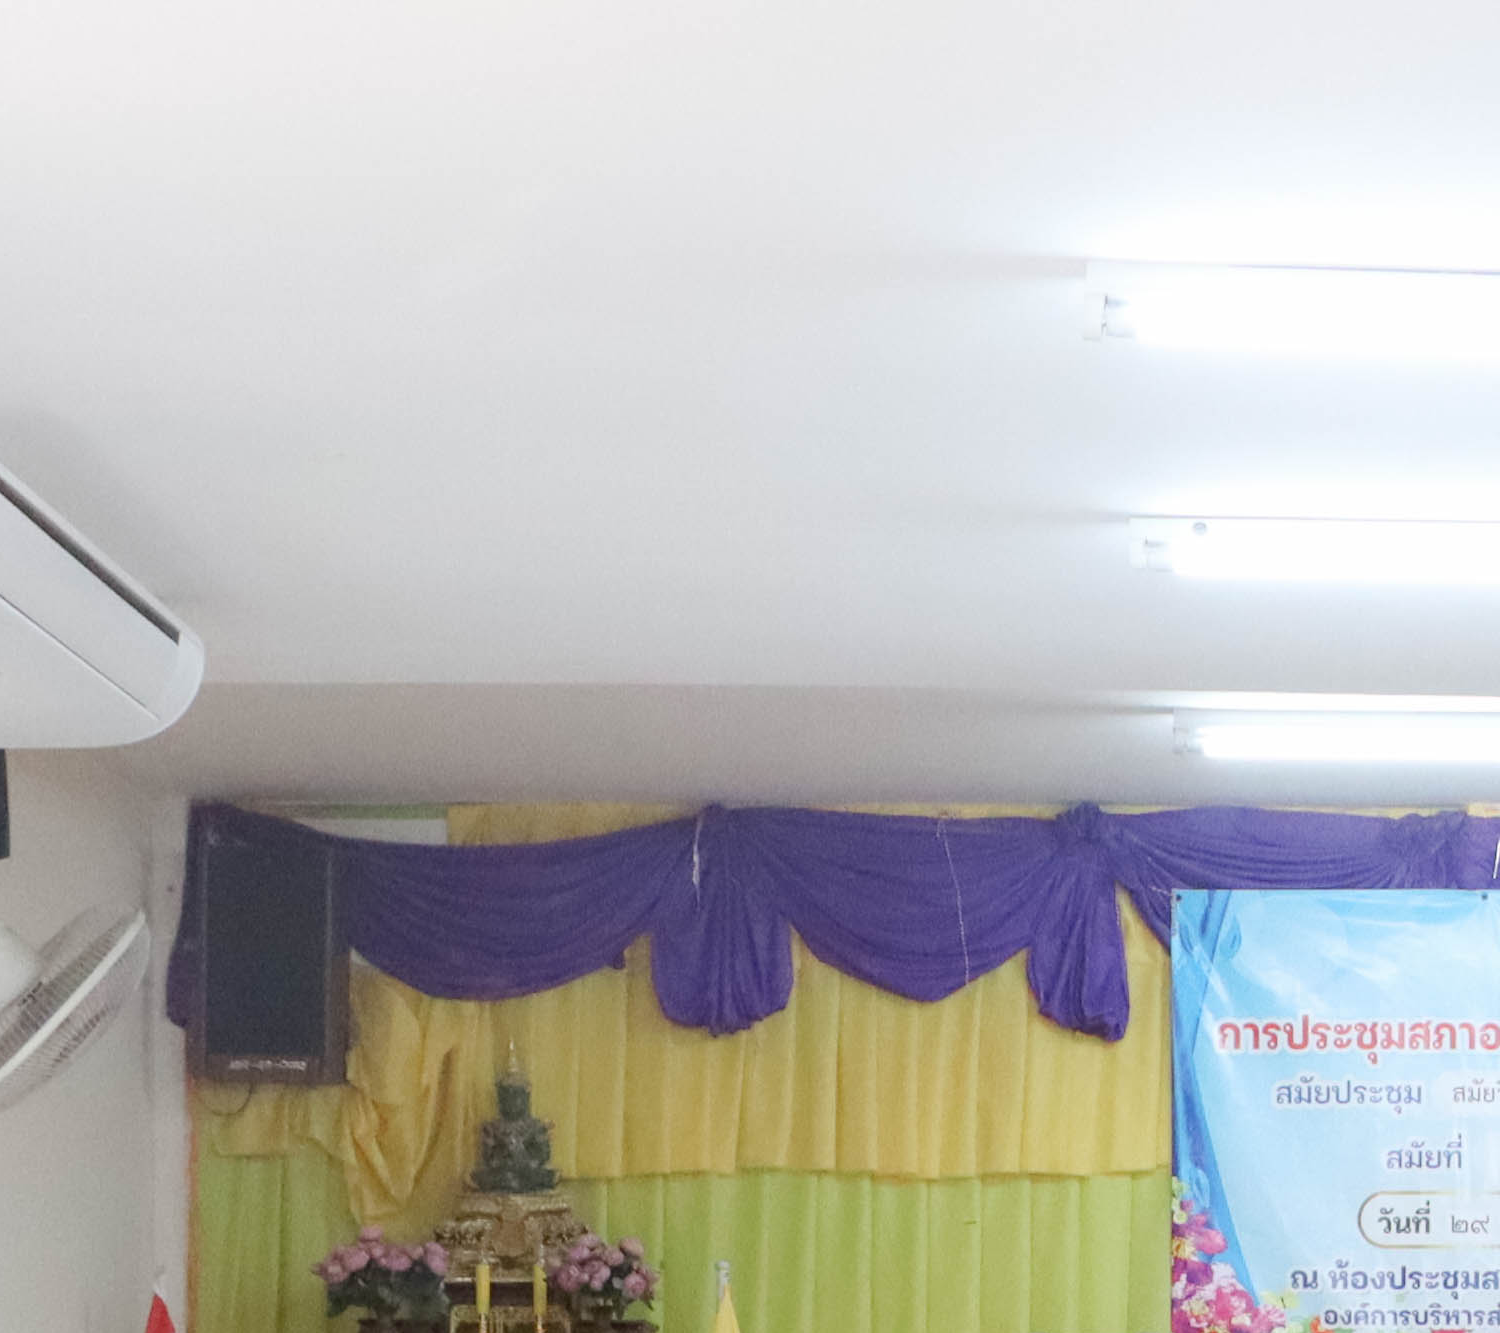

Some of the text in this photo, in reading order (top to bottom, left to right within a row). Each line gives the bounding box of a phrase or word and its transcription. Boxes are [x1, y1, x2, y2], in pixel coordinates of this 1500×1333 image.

[1275, 1076, 1422, 1115] สมัยประชุม
[1386, 1133, 1463, 1169] สมัยที่
[1377, 1200, 1431, 1235] วันที่
[1450, 1213, 1490, 1235] ๒๙
[1290, 1268, 1319, 1291] ณ
